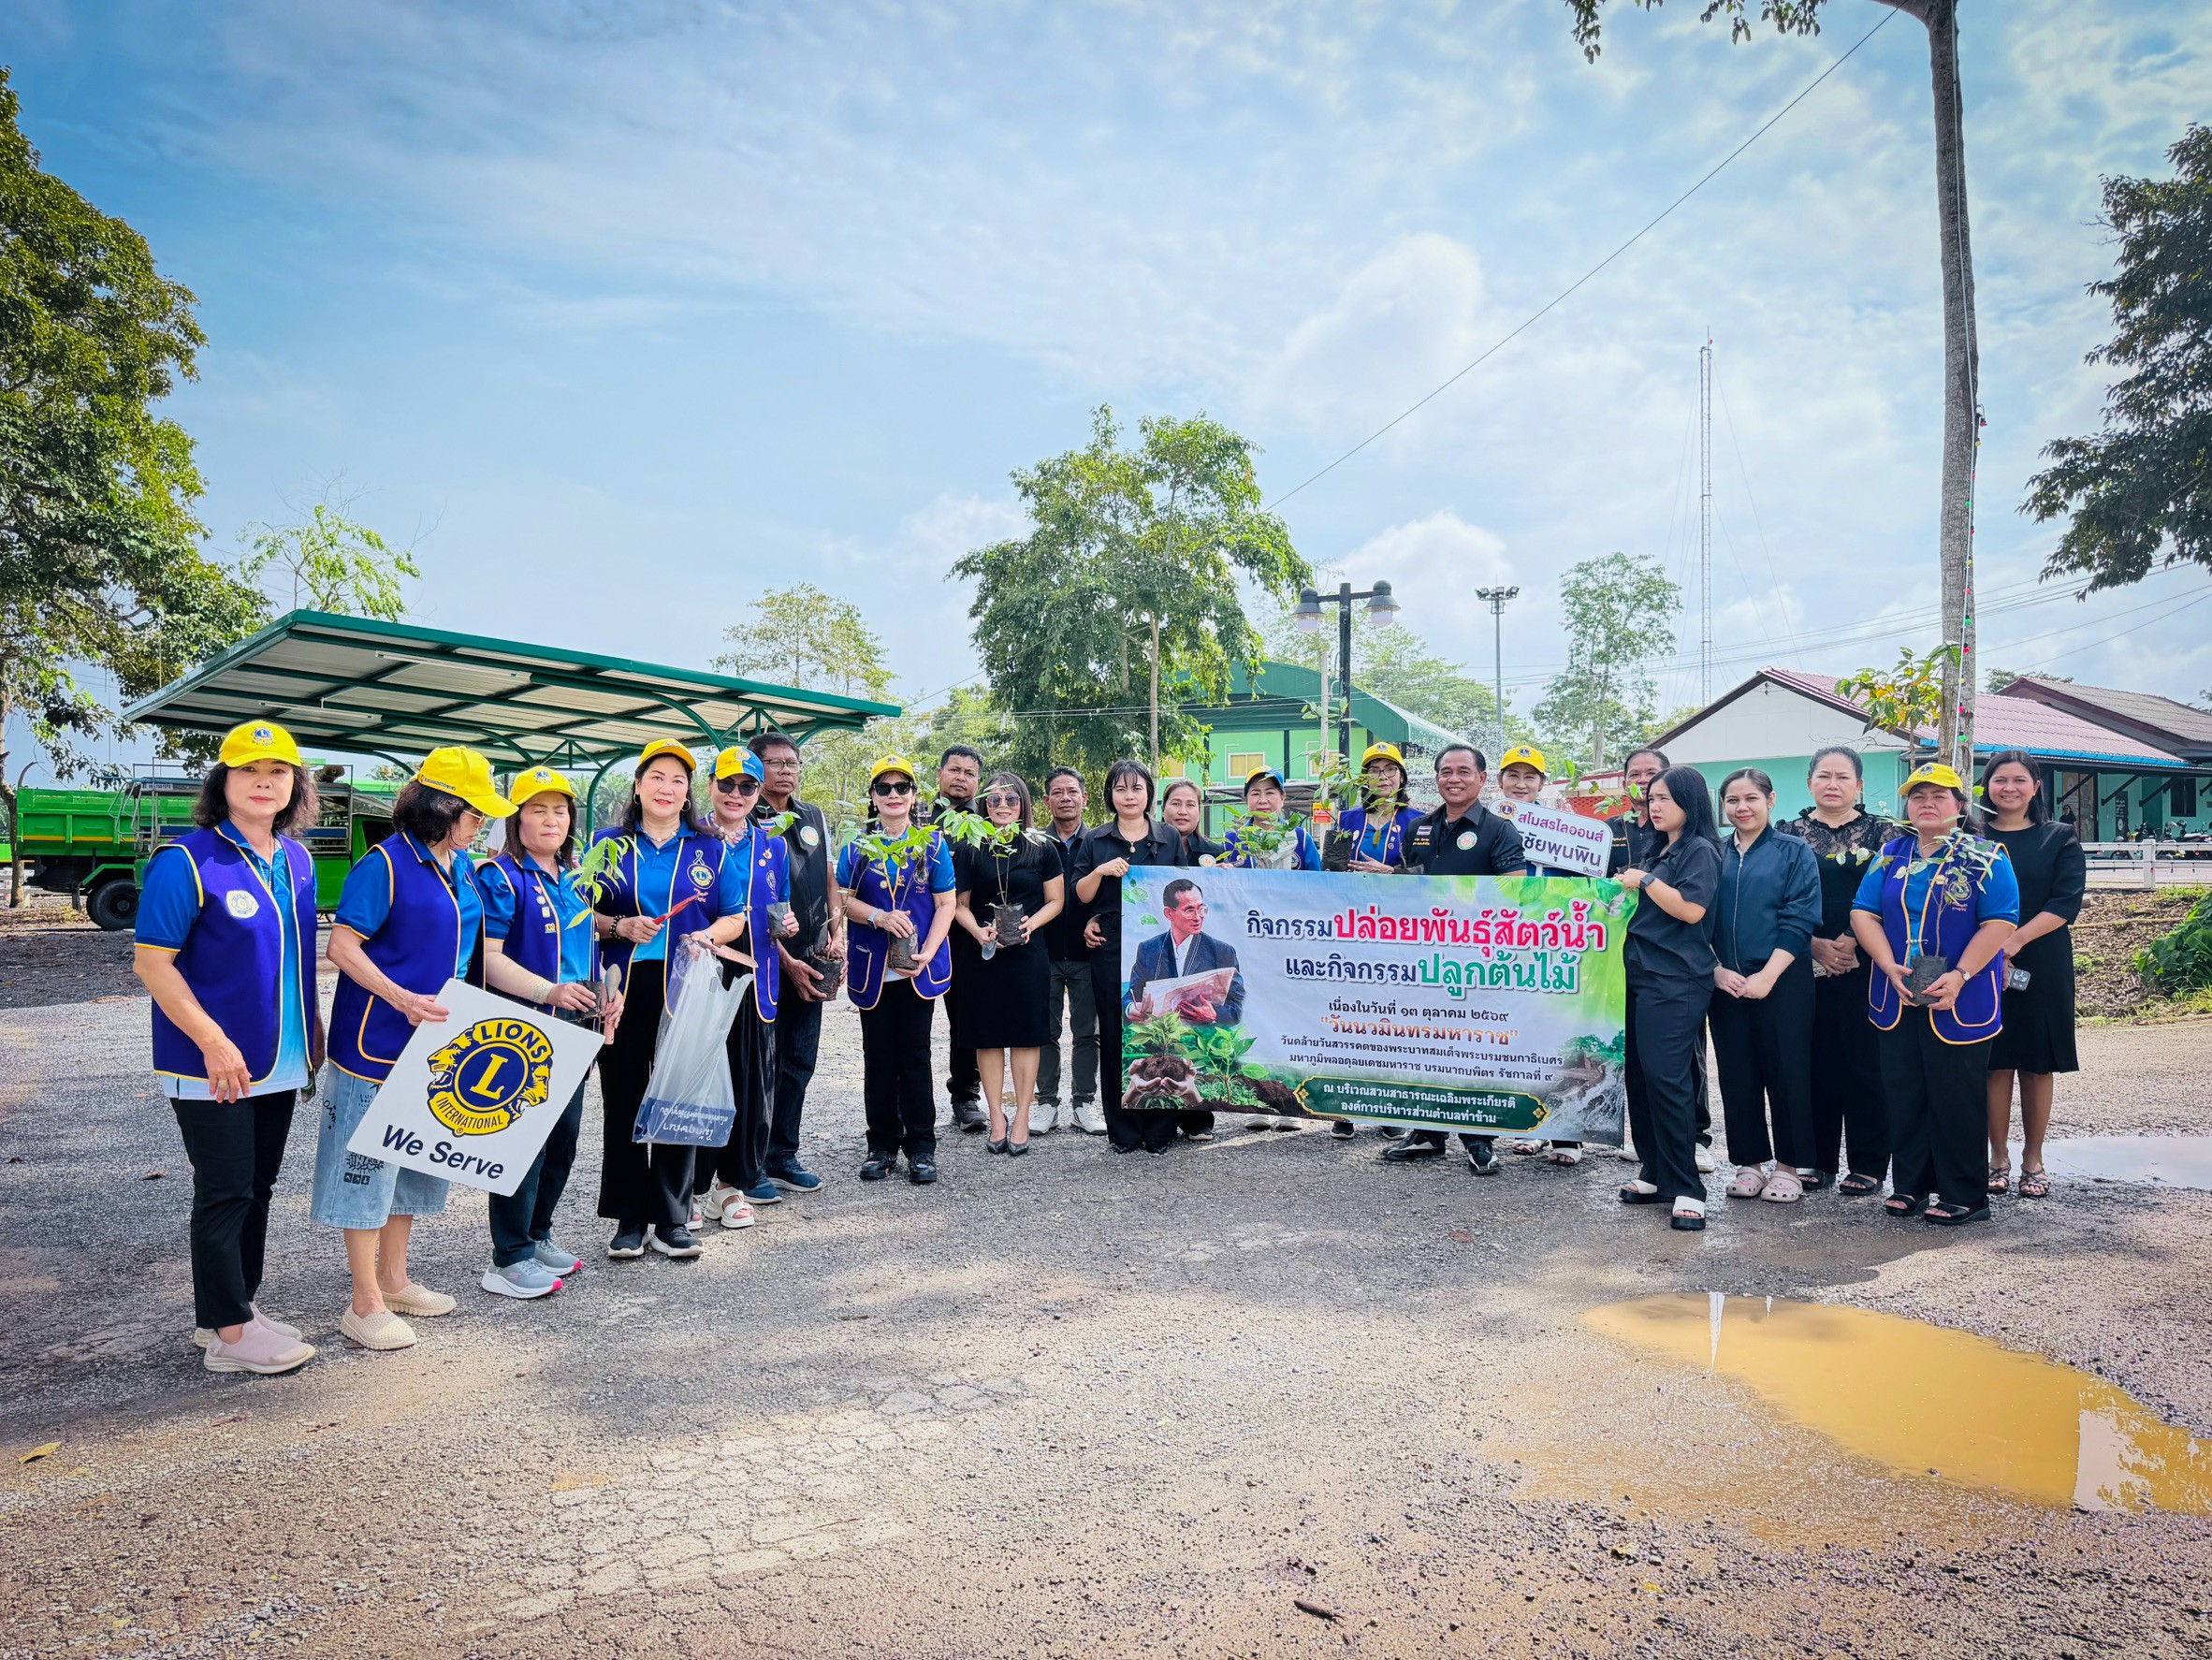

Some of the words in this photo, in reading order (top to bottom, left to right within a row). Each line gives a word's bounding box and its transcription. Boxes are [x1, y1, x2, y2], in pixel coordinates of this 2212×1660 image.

[1518, 811, 1605, 842] สโมสรไลออนส์
[1246, 901, 1605, 958] กิจกรรมปล่อยพันธุ์สัตว์น้ำ
[1286, 950, 1575, 997] และกิจกรรมปลูกต้นไม้
[1329, 996, 1396, 1015] เนื่องในวันที่
[1401, 1007, 1419, 1017] ๑๓
[1422, 1008, 1466, 1021] ตุลาคม
[480, 1022, 547, 1059] LIONS
[1320, 1013, 1519, 1045] "วันนวมินทรมหาราช"
[1280, 1034, 1564, 1065] วันคล้ายวันสวรรคตของพระบาทสมเด็จพระบรมชนกาธิเบศร
[470, 1053, 508, 1099] L
[1289, 1053, 1421, 1071] มหาภูมิพลอดุลยเดชมหาราช
[1424, 1063, 1495, 1077] บรมนาถบพิตร
[1498, 1067, 1541, 1081] รัชกาลที่
[1544, 1073, 1553, 1082] ๙
[1323, 1084, 1334, 1093] ณ
[1336, 1083, 1516, 1109] บริเวณสวนสาธารณะเฉลิมพระเกียรติ
[1341, 1099, 1497, 1124] องค์การบริหารส่วนตำบลท่าข้าม
[435, 1096, 503, 1129] INTERNATIONAL
[382, 1124, 424, 1157] We
[429, 1141, 504, 1179] Serve
